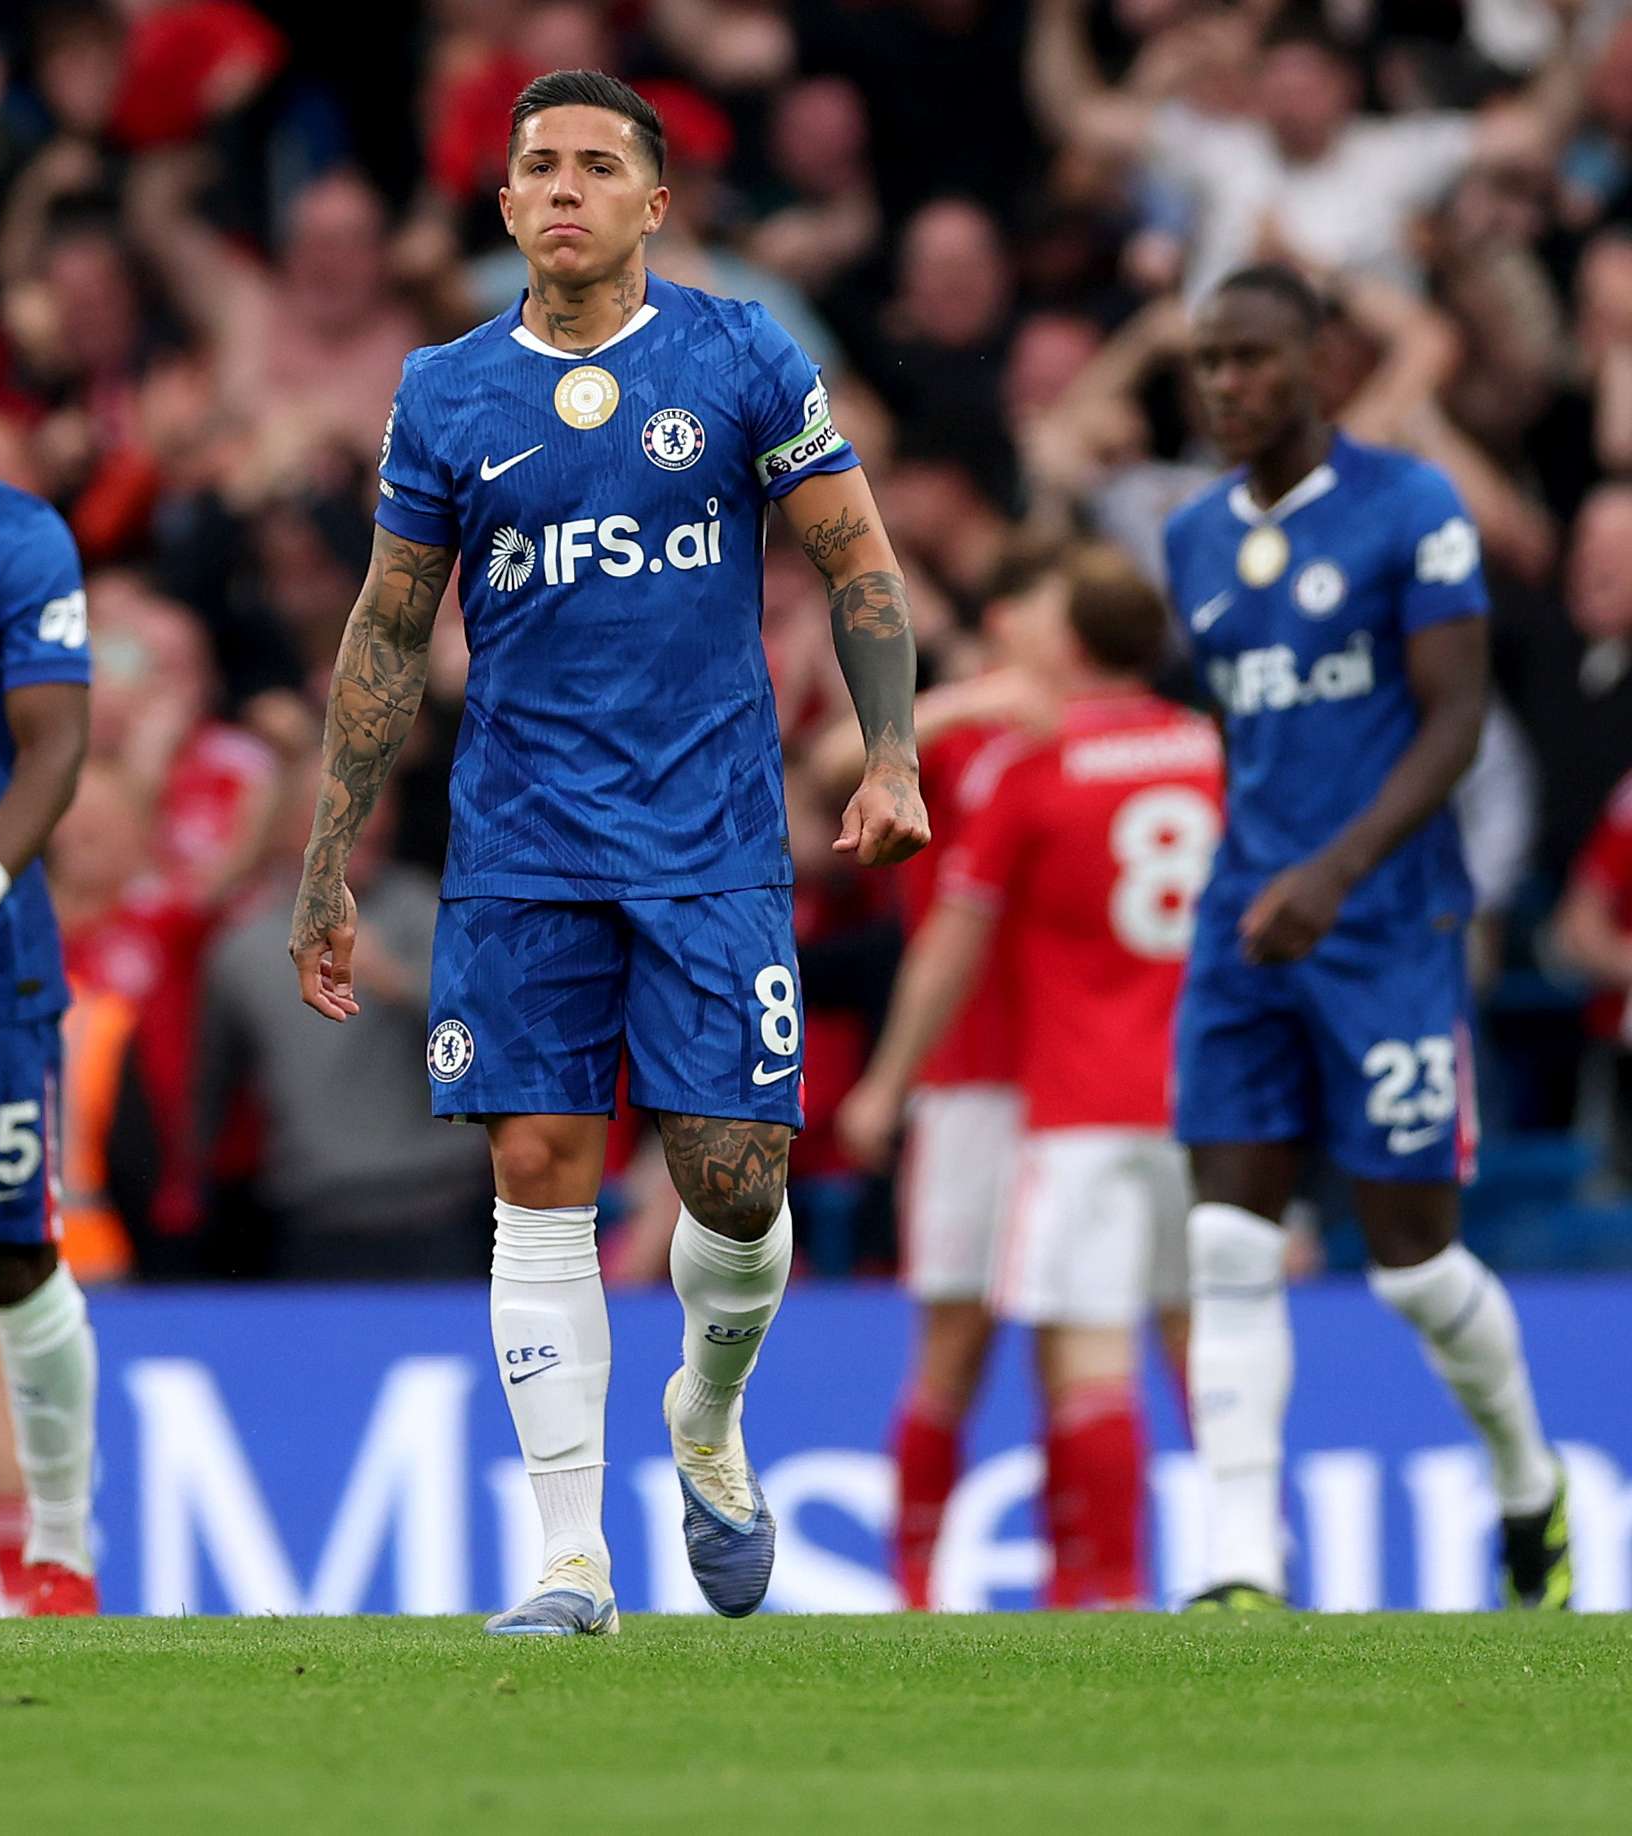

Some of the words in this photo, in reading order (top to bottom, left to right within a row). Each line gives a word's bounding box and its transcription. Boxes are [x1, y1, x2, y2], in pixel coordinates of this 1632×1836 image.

[577, 412, 602, 425] FIFA
[651, 411, 691, 426] CHELSEA
[543, 496, 722, 586] IFS.ai
[1109, 785, 1220, 958] 8
[754, 965, 798, 1056] 8
[1363, 1036, 1459, 1128] 23
[506, 1345, 559, 1365] CFC
[707, 1323, 761, 1339] CFC
